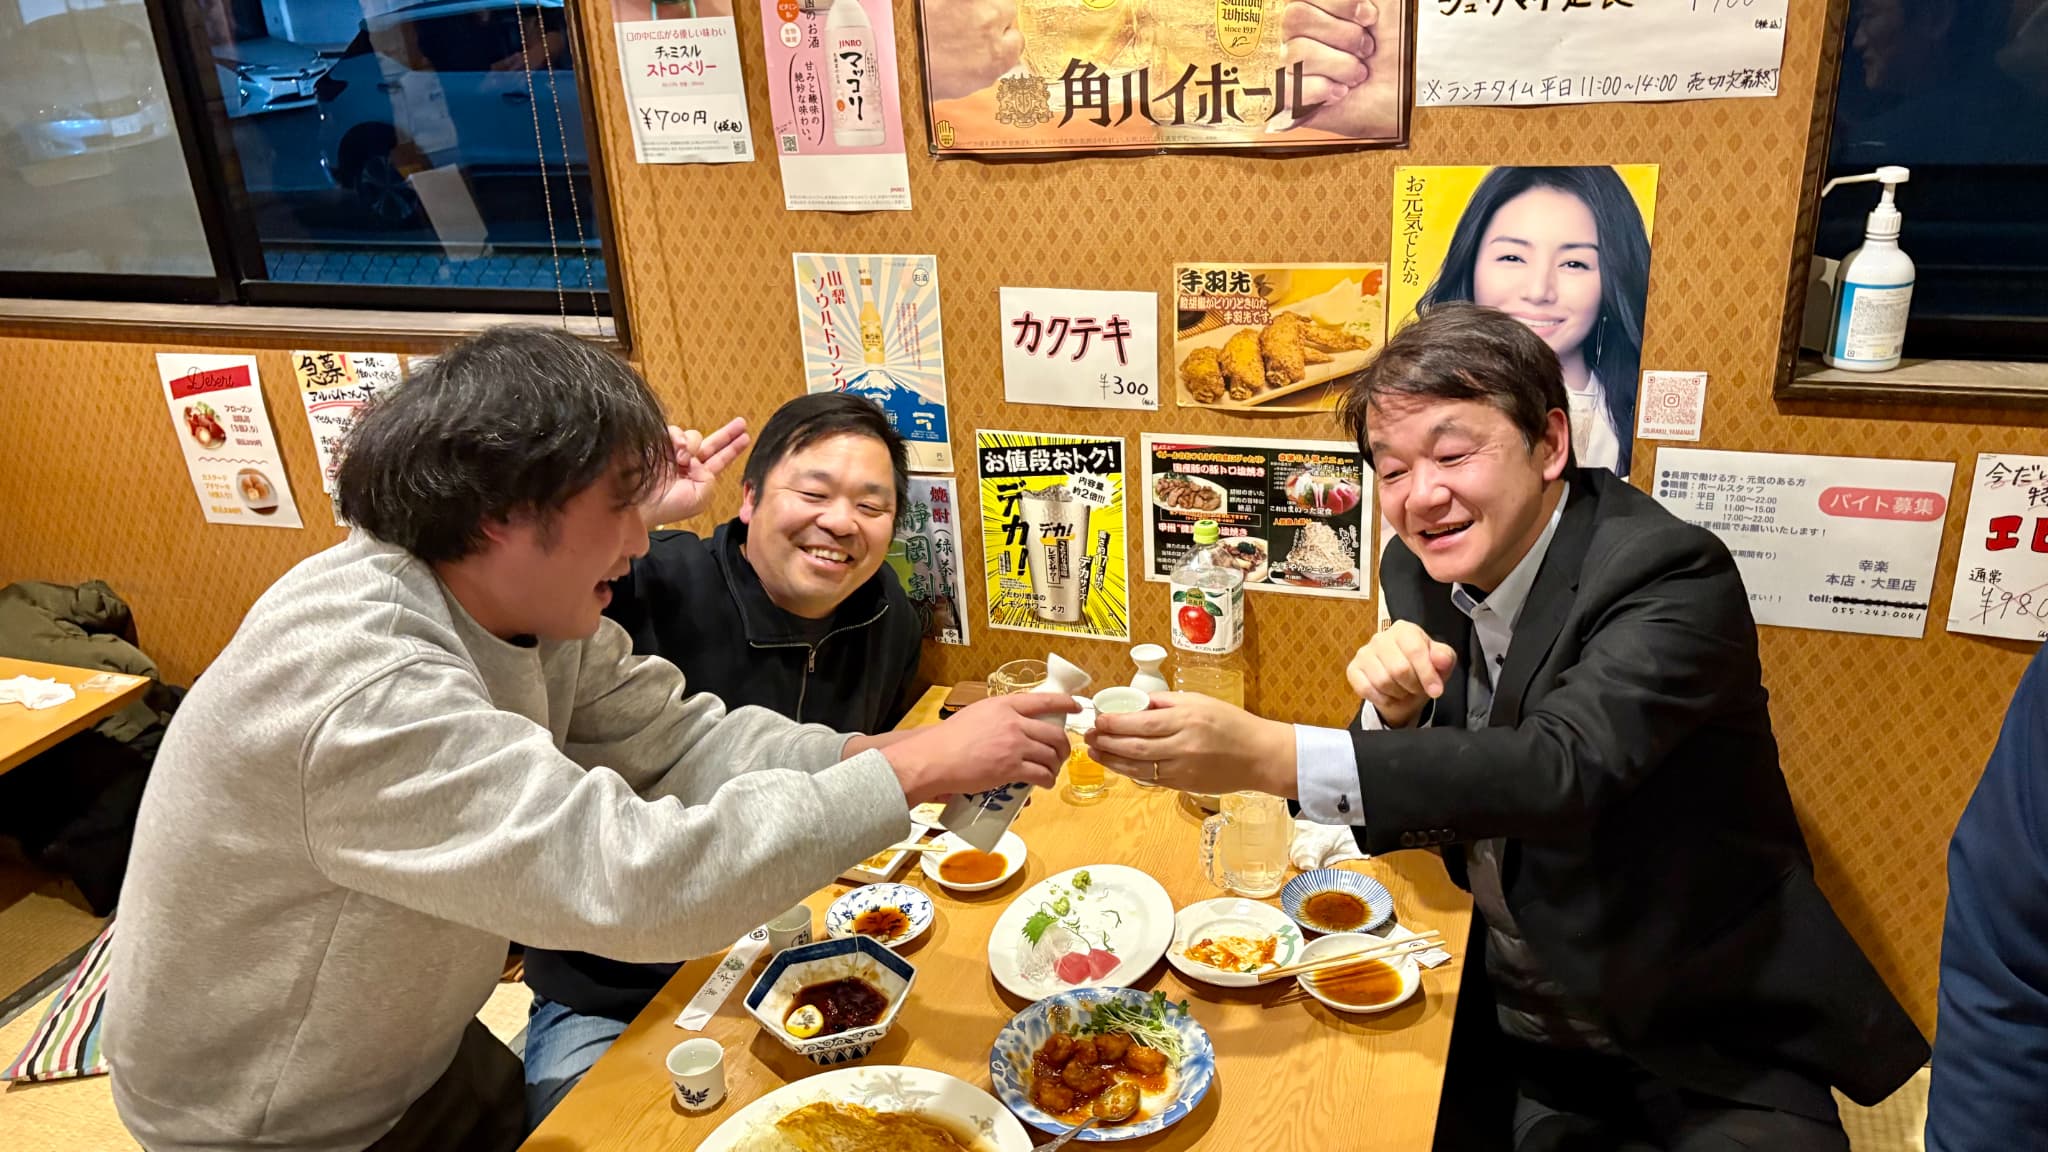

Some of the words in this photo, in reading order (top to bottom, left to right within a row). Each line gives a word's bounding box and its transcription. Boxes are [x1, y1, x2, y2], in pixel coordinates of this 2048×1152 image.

[1222, 8, 1261, 24] Whisky
[626, 28, 727, 41] 口の中に広がる優しい味わい
[839, 39, 862, 48] JINRO
[655, 44, 701, 59] チャミスル
[647, 60, 717, 77] ストロベリー
[804, 61, 820, 125] 甘みと酸味の
[839, 52, 864, 121] マッコリ
[1057, 57, 1306, 129] 角ハイボール
[1541, 77, 1573, 102] 平日
[794, 72, 812, 141] 絶妙な味わい。
[1402, 174, 1426, 287] お元気でしたか。
[914, 273, 929, 282] お酒
[1181, 270, 1251, 293] 手羽先
[827, 270, 846, 305] 山梨
[1223, 311, 1273, 324] 手羽先です。
[812, 276, 848, 392] ソウルドリンク
[1012, 311, 1132, 365] カクテキ
[1100, 373, 1149, 400] ¥300
[984, 446, 1116, 473] お値段おトク!
[1078, 476, 1104, 491] 内容量
[1671, 471, 1806, 487] 長期で働ける方・元気のある方
[1696, 502, 1714, 511] 土日
[1830, 492, 1936, 517] バイト募集
[1040, 522, 1073, 538] デカ!
[1858, 560, 1889, 572] 幸楽
[1824, 573, 1917, 592] 本店・大里店
[1968, 567, 2002, 585] 通常
[1001, 601, 1047, 612] レモンサワー
